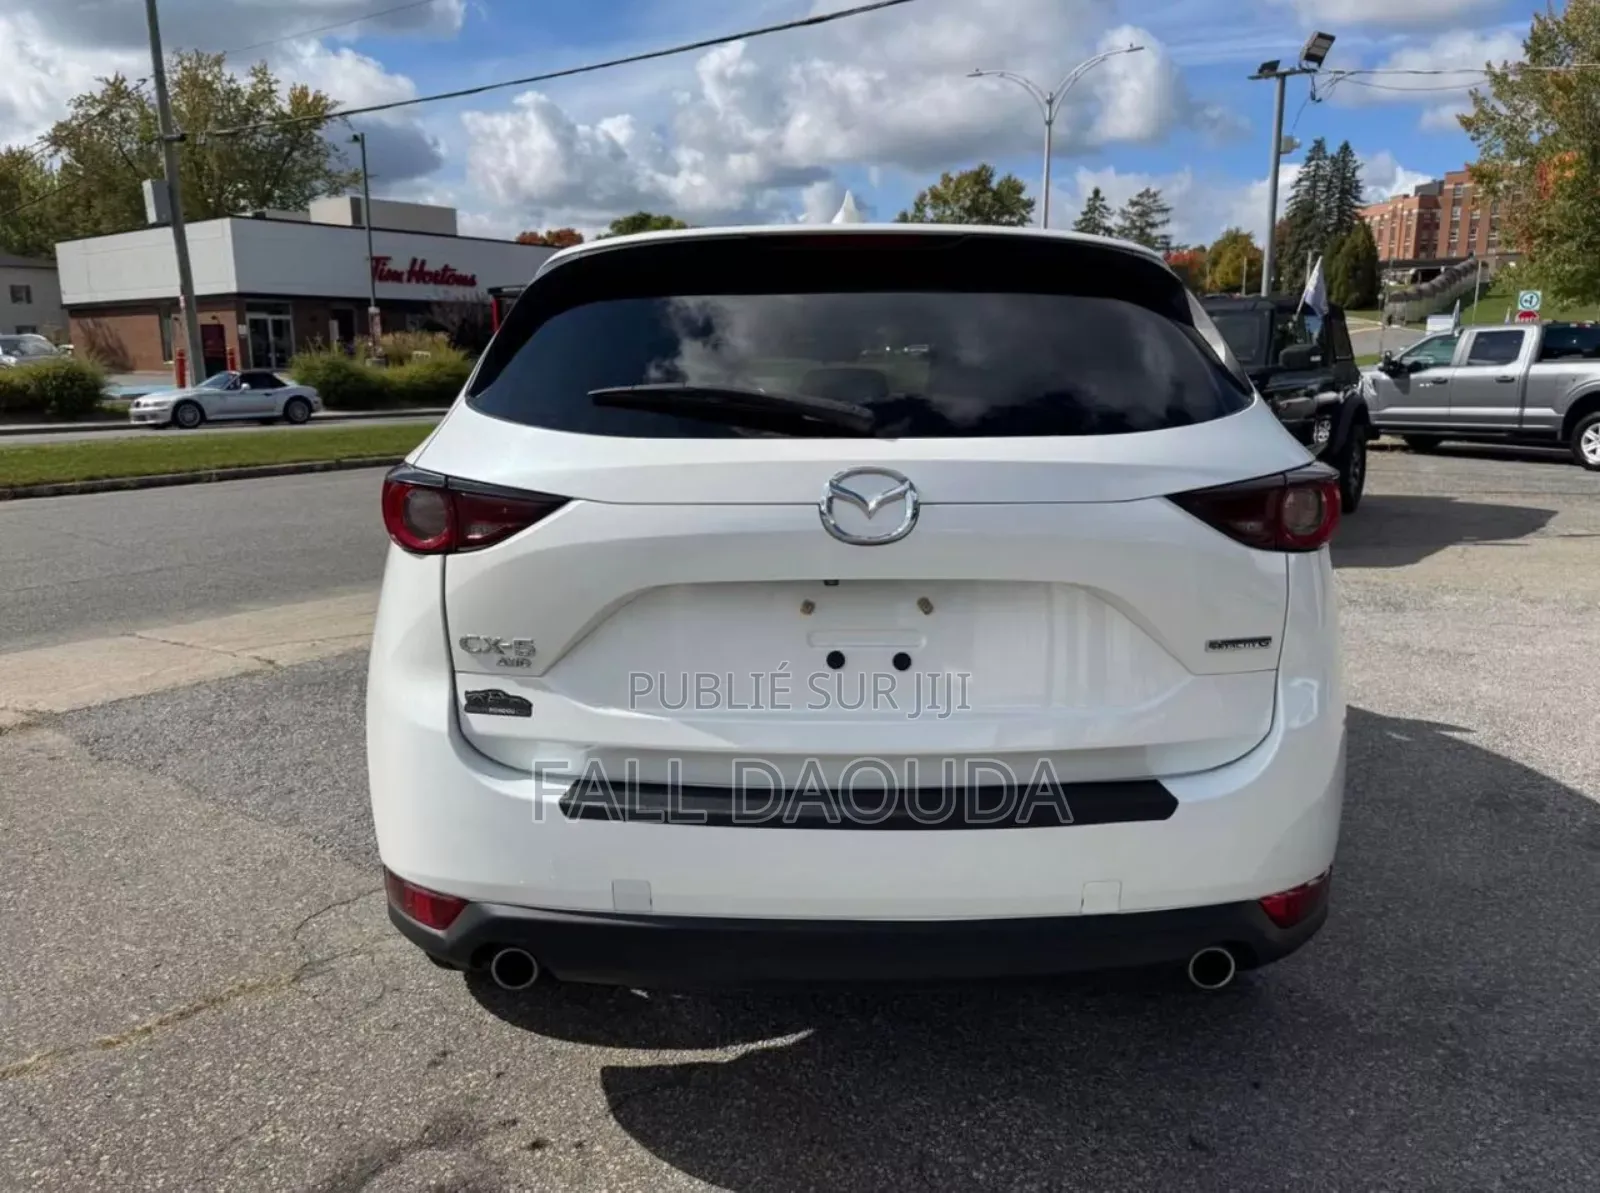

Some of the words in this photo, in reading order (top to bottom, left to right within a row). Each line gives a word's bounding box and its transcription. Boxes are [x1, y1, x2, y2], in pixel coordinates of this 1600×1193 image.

[367, 256, 404, 283] Tim
[406, 256, 477, 287] Hortons
[459, 634, 536, 657] CX-5
